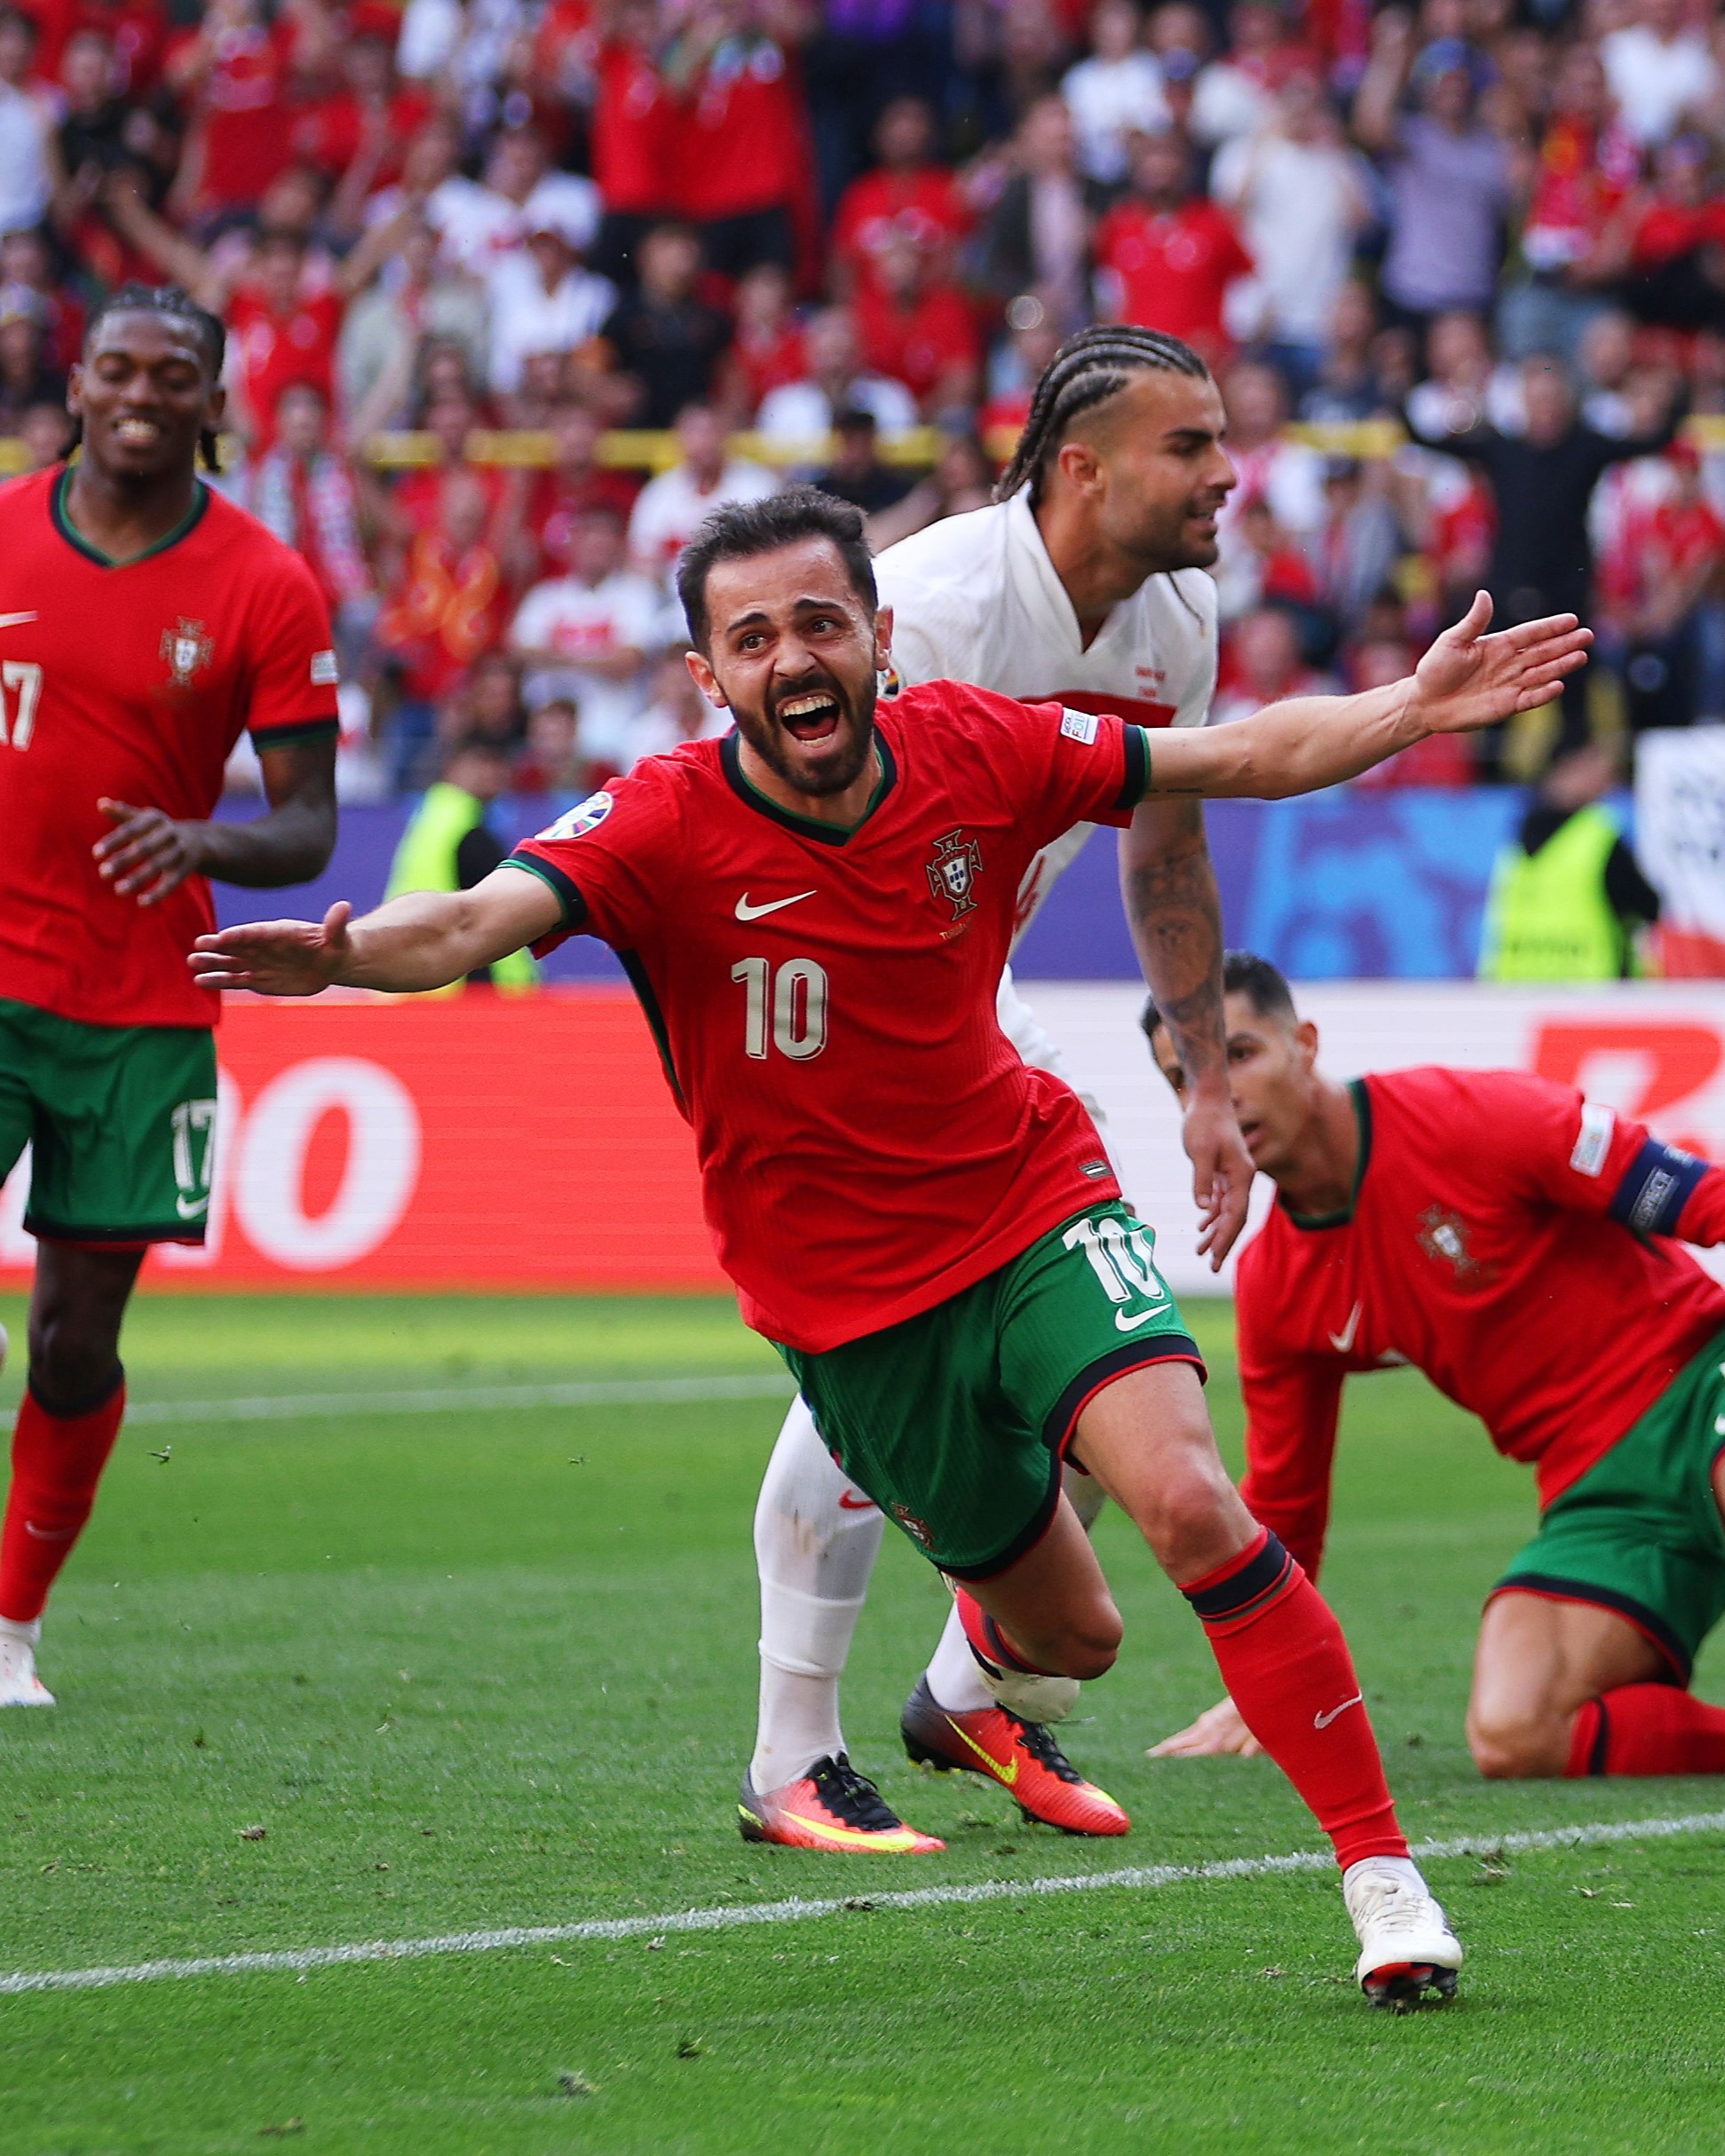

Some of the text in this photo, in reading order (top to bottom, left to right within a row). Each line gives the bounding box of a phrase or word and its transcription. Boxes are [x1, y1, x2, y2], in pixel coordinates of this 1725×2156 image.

[0, 659, 44, 752] 7
[731, 957, 827, 1060] 10
[170, 1098, 217, 1192] 17
[1062, 1218, 1165, 1303] 10
